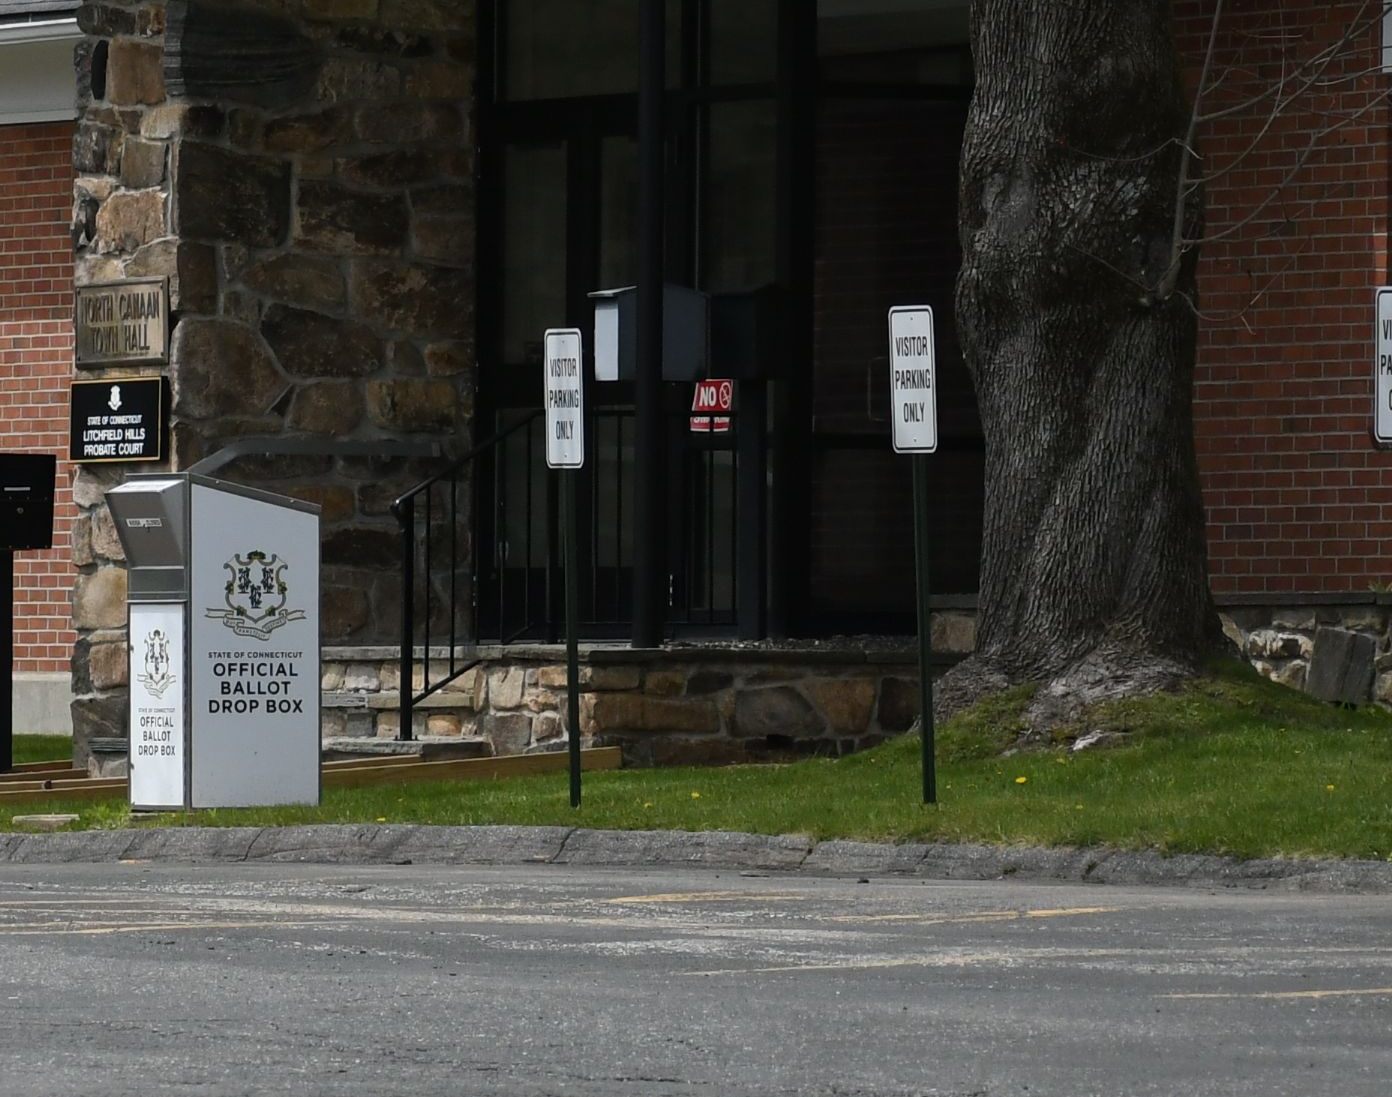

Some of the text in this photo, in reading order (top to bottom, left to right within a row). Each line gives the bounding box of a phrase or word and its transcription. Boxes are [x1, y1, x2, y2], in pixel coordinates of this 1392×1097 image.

[81, 291, 159, 324] NORTH CANAAN
[90, 324, 150, 353] TOWN HALL
[896, 336, 928, 357] VISITOR
[550, 358, 577, 377] VISITOR
[896, 369, 931, 389] PARKING
[550, 390, 579, 408] PARKING
[699, 386, 716, 406] NO
[87, 415, 142, 425] STATE OF CONNECTICUT
[903, 402, 925, 423] ONLY
[83, 428, 145, 442] LITCHFIELD HILLS
[556, 421, 574, 440] ONLY
[84, 443, 144, 456] PROBATE COURT
[213, 663, 298, 677] OFFICIAL
[221, 681, 291, 695] BALLOT
[208, 699, 303, 713] DROP BOX
[140, 716, 174, 727] OFFICIAL
[143, 730, 171, 742] BALLOT
[138, 745, 176, 756] DROP BOX
